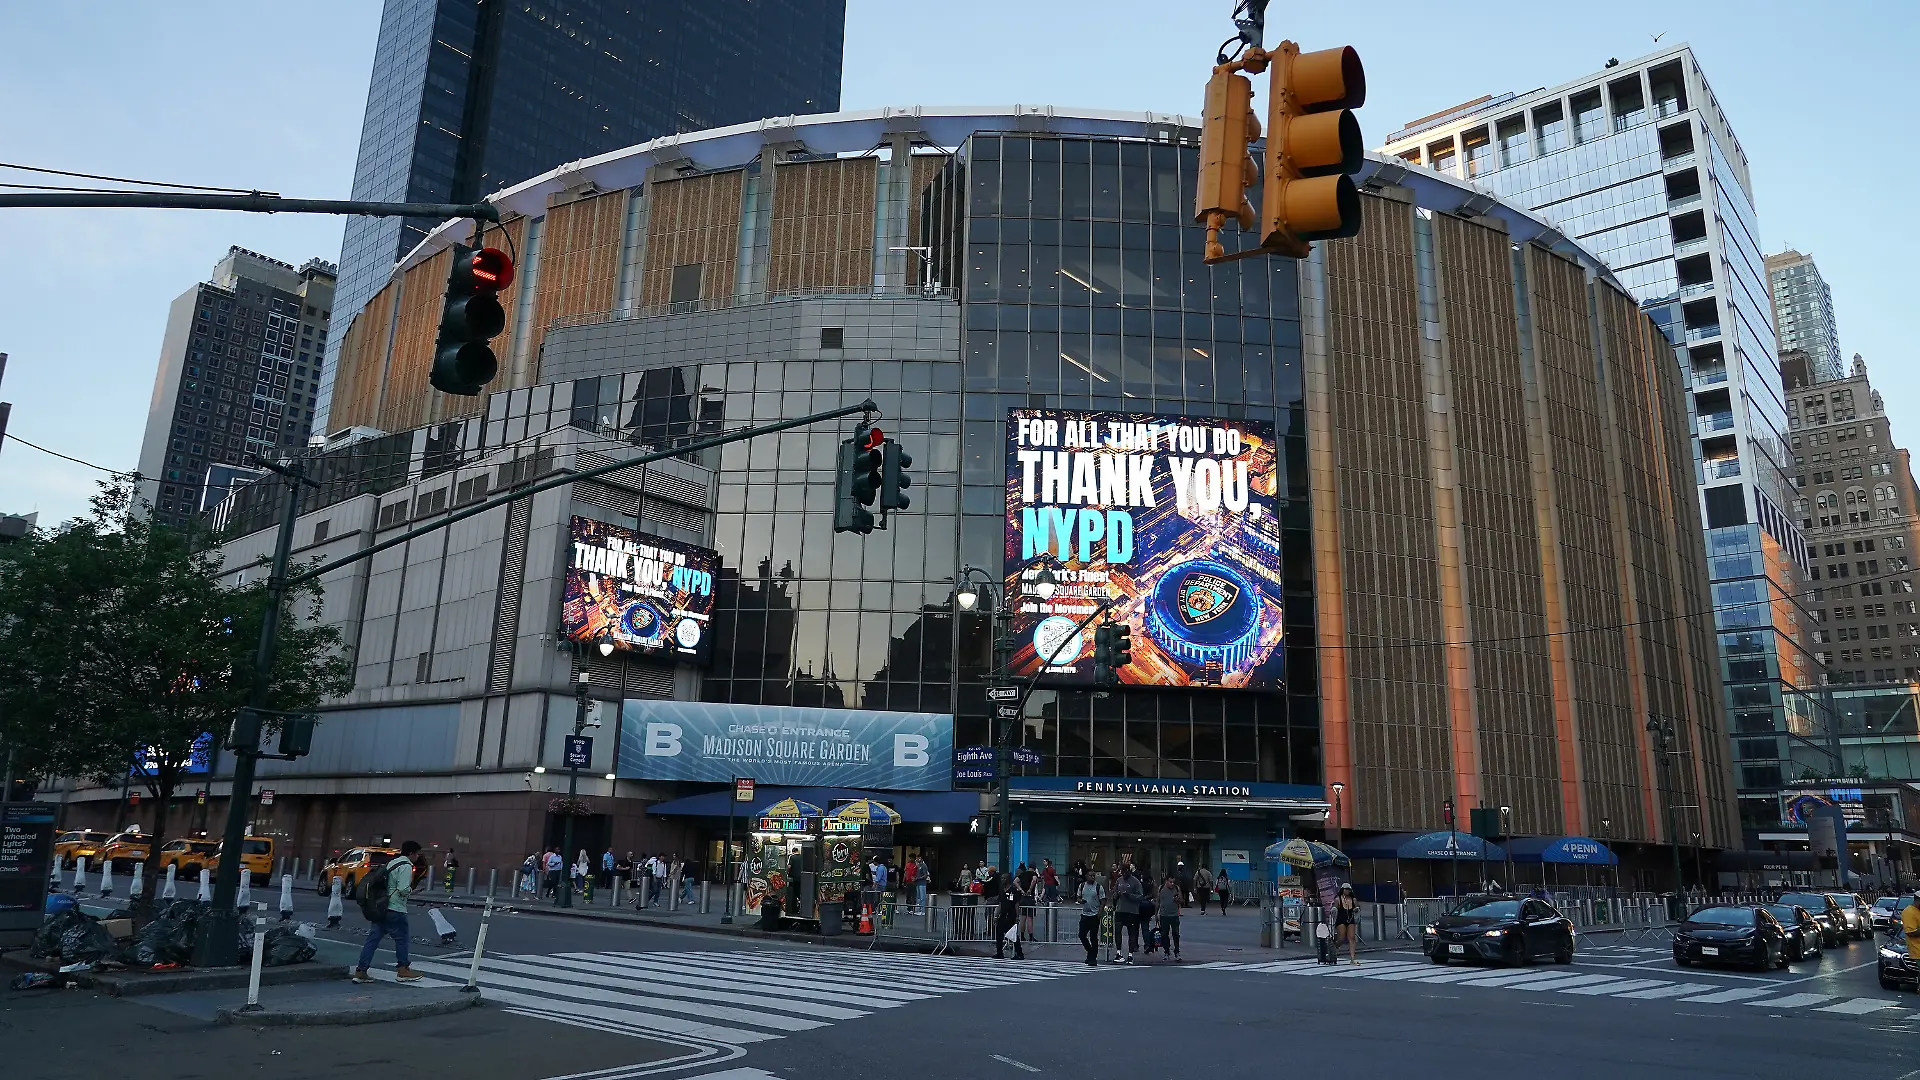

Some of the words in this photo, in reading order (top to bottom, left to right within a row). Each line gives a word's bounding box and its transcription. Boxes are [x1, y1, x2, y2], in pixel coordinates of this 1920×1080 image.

[1017, 419, 1058, 447] FOR
[1064, 420, 1102, 449] ALL
[1108, 421, 1160, 450] THAT
[1165, 425, 1206, 453] YOU
[1213, 427, 1241, 456] DO
[1017, 450, 1156, 508] THANK
[1168, 456, 1262, 520] YOU,
[1022, 506, 1133, 564] NYPD
[574, 541, 630, 580] THANK
[634, 555, 668, 591] YOU,
[673, 564, 712, 597] NYPD
[1055, 584, 1082, 596] SQUARE
[1083, 585, 1111, 597] GARDEN
[1184, 579, 1233, 600] DEPARTMENT
[1021, 602, 1039, 613] Join
[1039, 603, 1053, 614] the
[728, 724, 766, 735] CHASE
[782, 726, 850, 738] ENTRANCE
[644, 722, 683, 757] B
[703, 734, 762, 757] MADISON
[766, 737, 815, 760] SQUARE
[894, 733, 931, 767] B
[957, 751, 978, 763] Eighth
[980, 751, 993, 760] Ave
[956, 770, 966, 778] Joe
[967, 769, 982, 778] Louis
[1077, 781, 1187, 794] PENNSYLVANIA
[1193, 785, 1251, 796] STATION
[763, 819, 781, 830] Ebru
[782, 819, 801, 830] Halal
[1, 847, 33, 855] Imagine
[2, 840, 27, 848] Lyfts?
[1562, 843, 1570, 852] 4
[1570, 843, 1598, 854] PENN
[832, 846, 849, 859] Ebru
